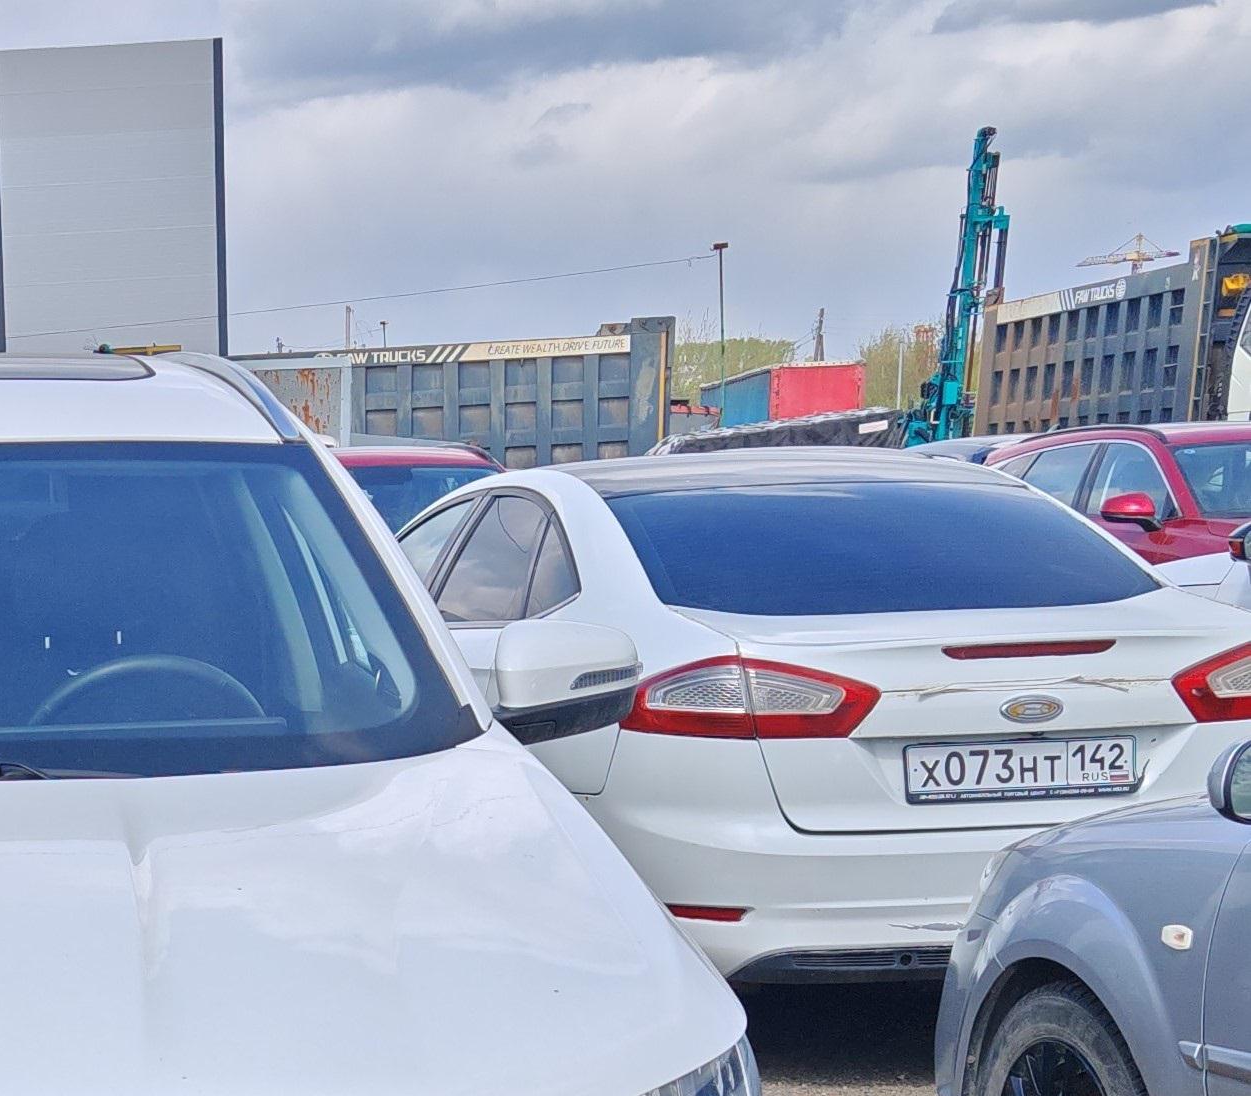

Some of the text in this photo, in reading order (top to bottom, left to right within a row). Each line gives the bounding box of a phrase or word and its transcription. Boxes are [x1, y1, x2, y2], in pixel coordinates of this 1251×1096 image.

[592, 338, 626, 350] FUTURE
[371, 350, 426, 364] TRUCKS
[1072, 743, 1124, 772] 142
[1082, 771, 1109, 782] RUS
